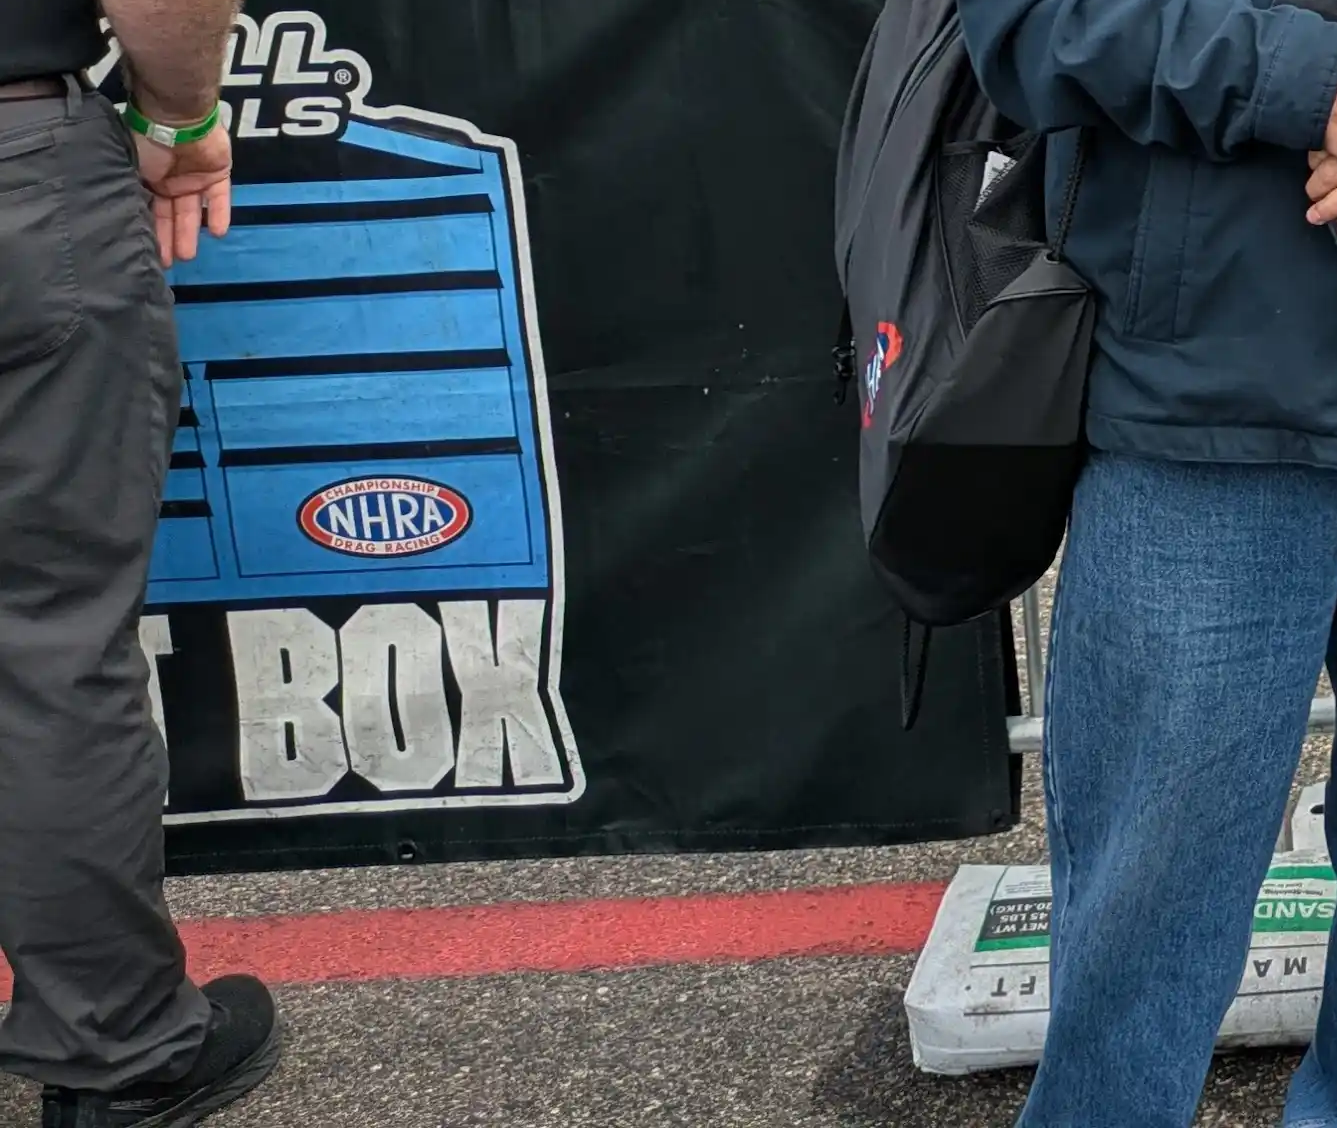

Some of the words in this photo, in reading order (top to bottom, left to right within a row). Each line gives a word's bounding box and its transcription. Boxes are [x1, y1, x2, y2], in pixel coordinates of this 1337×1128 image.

[221, 96, 343, 139] LS
[325, 480, 435, 500] CHAMPIONSHIP
[328, 493, 446, 540] NHRA
[334, 537, 376, 553] DRAG
[384, 532, 441, 553] RACING
[226, 599, 564, 801] BOX
[999, 913, 1027, 924] LBS
[1029, 911, 1049, 921] 45
[992, 923, 1017, 934] WT.
[1019, 921, 1049, 932] NET
